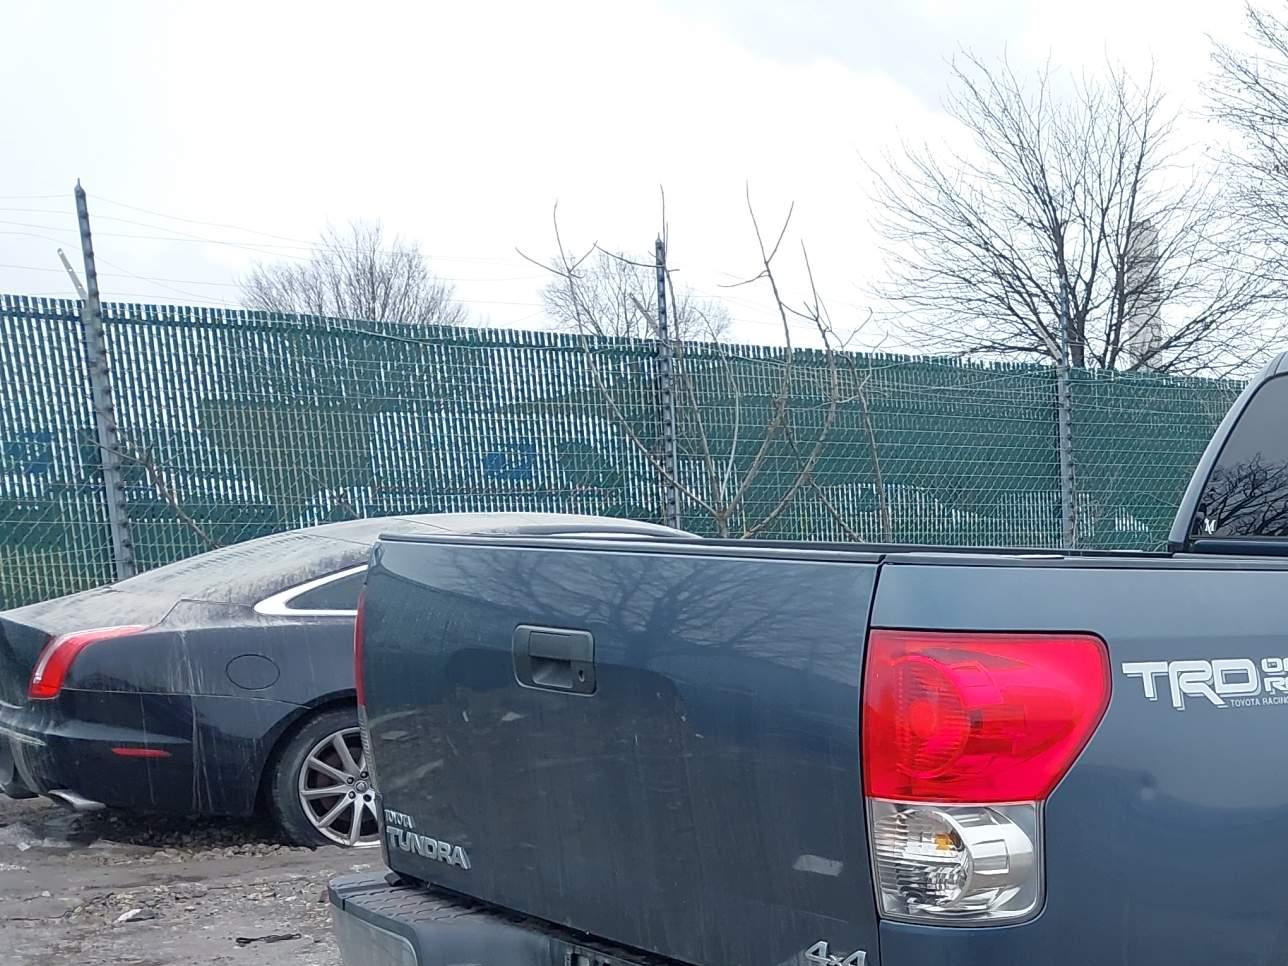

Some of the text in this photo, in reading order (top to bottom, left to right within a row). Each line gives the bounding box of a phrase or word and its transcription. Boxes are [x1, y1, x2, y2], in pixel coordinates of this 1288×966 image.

[1121, 658, 1262, 711] TRD
[1230, 697, 1261, 707] TOYOTA
[384, 809, 415, 829] TOYOTA
[386, 825, 472, 870] TUNDRA
